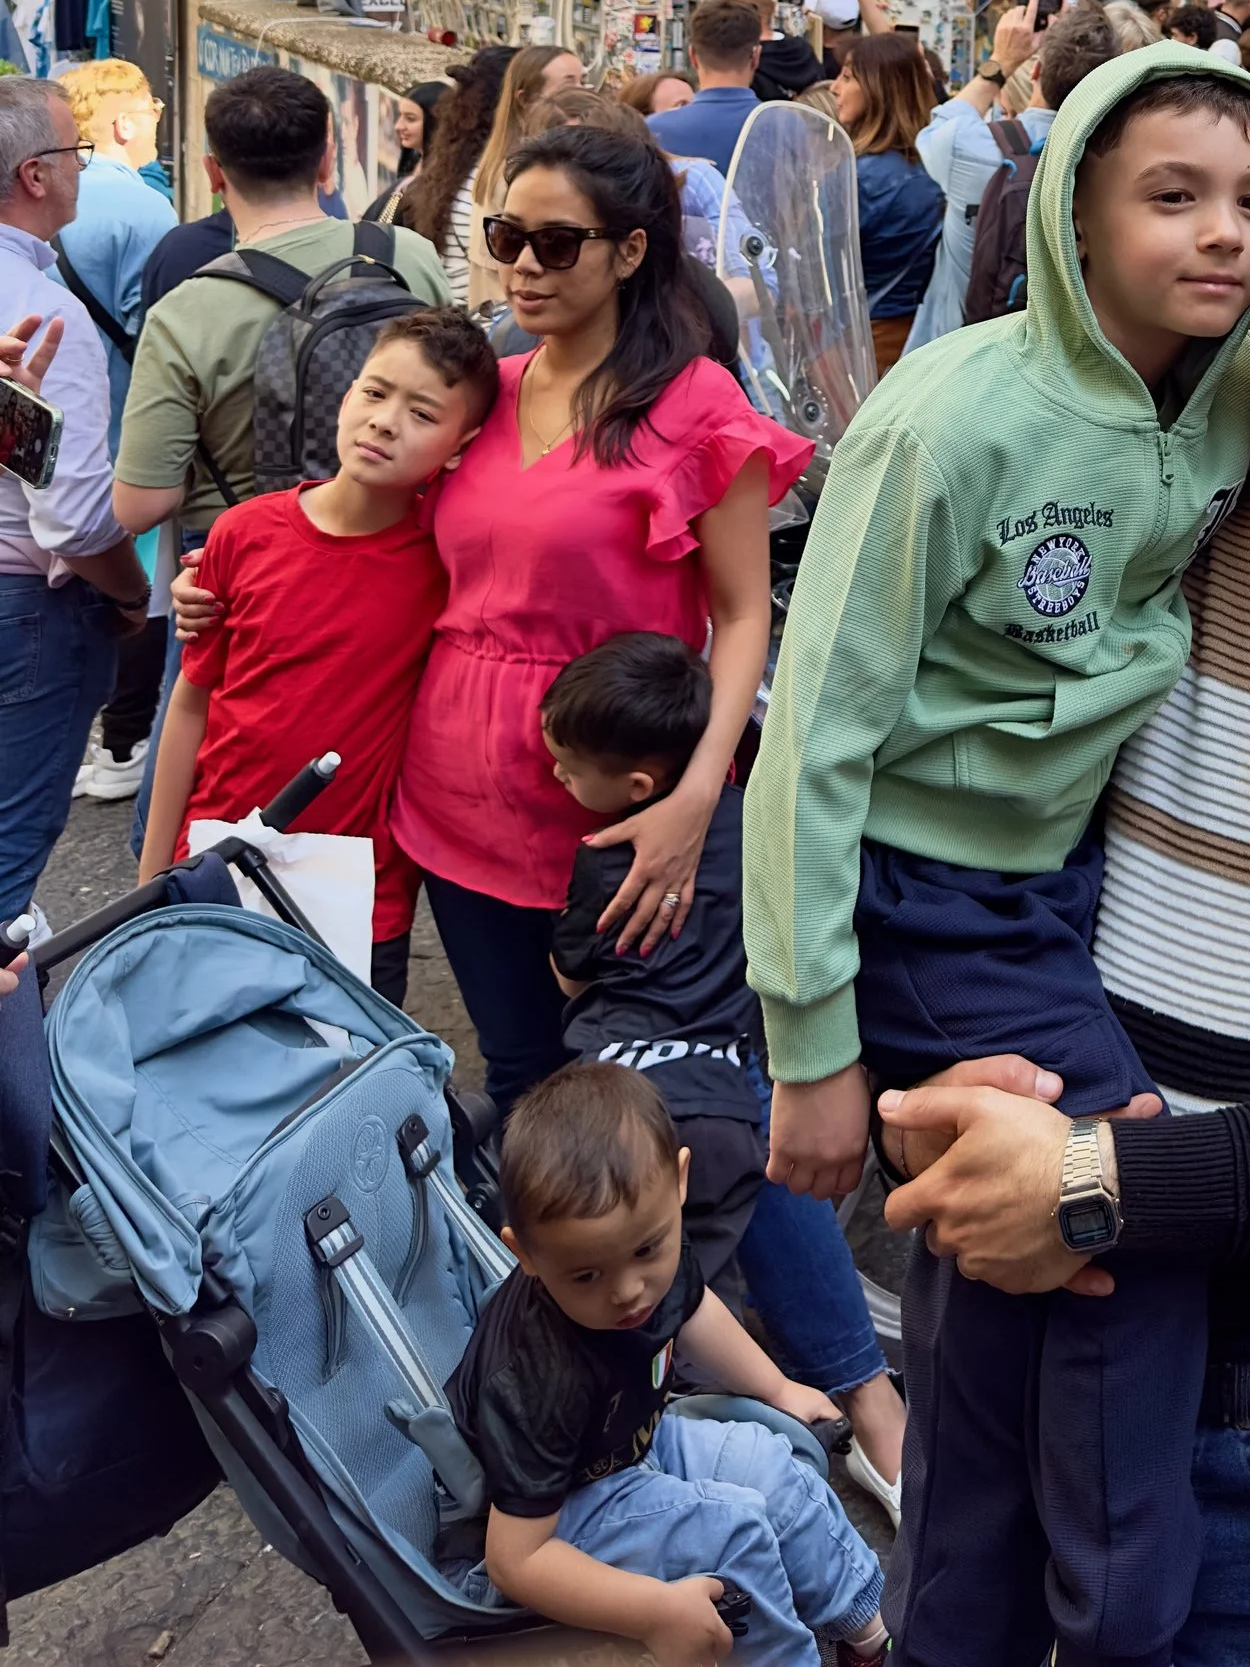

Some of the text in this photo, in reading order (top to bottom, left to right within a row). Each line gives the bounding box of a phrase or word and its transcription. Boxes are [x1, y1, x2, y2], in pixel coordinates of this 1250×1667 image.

[996, 500, 1115, 548] Los Angeles
[1030, 536, 1086, 565] NEW YORK
[1017, 554, 1093, 589] Baseball
[1004, 610, 1100, 644] Basketball
